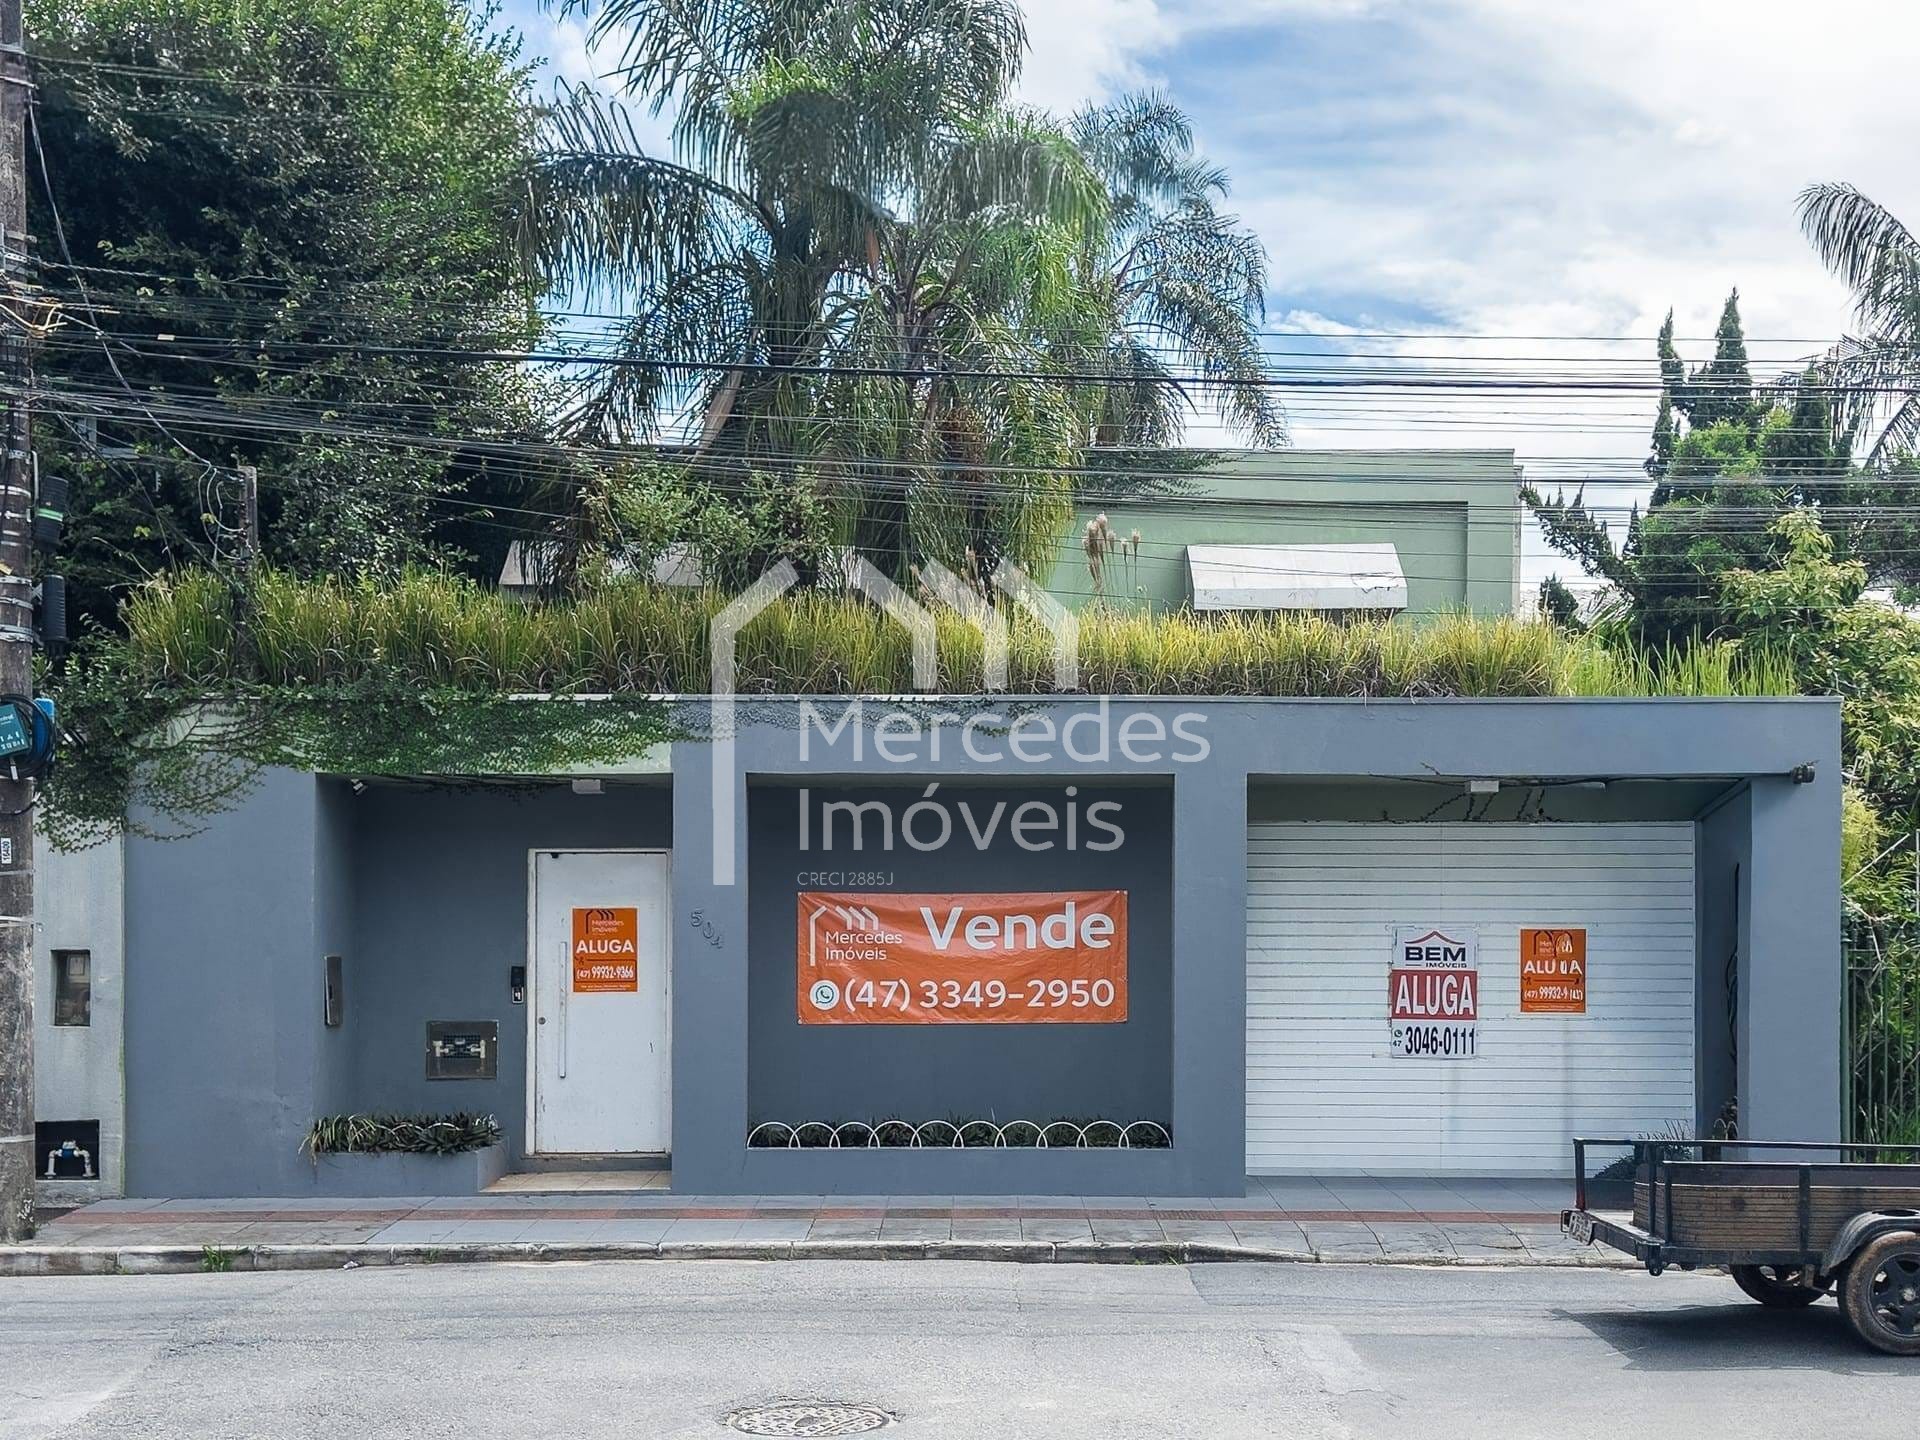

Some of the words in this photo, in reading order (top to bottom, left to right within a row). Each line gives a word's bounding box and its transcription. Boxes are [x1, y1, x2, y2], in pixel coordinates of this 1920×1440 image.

[919, 901, 1115, 950] Vende
[576, 939, 635, 954] ALUGA
[825, 931, 903, 944] Mercedes
[825, 946, 887, 960] Imóveis
[1405, 946, 1466, 961] BEM
[844, 978, 911, 1012] (47)
[919, 978, 1116, 1009] 3349-2950
[1395, 974, 1475, 1016] ALUGA
[1405, 1026, 1475, 1055] 3046-0111
